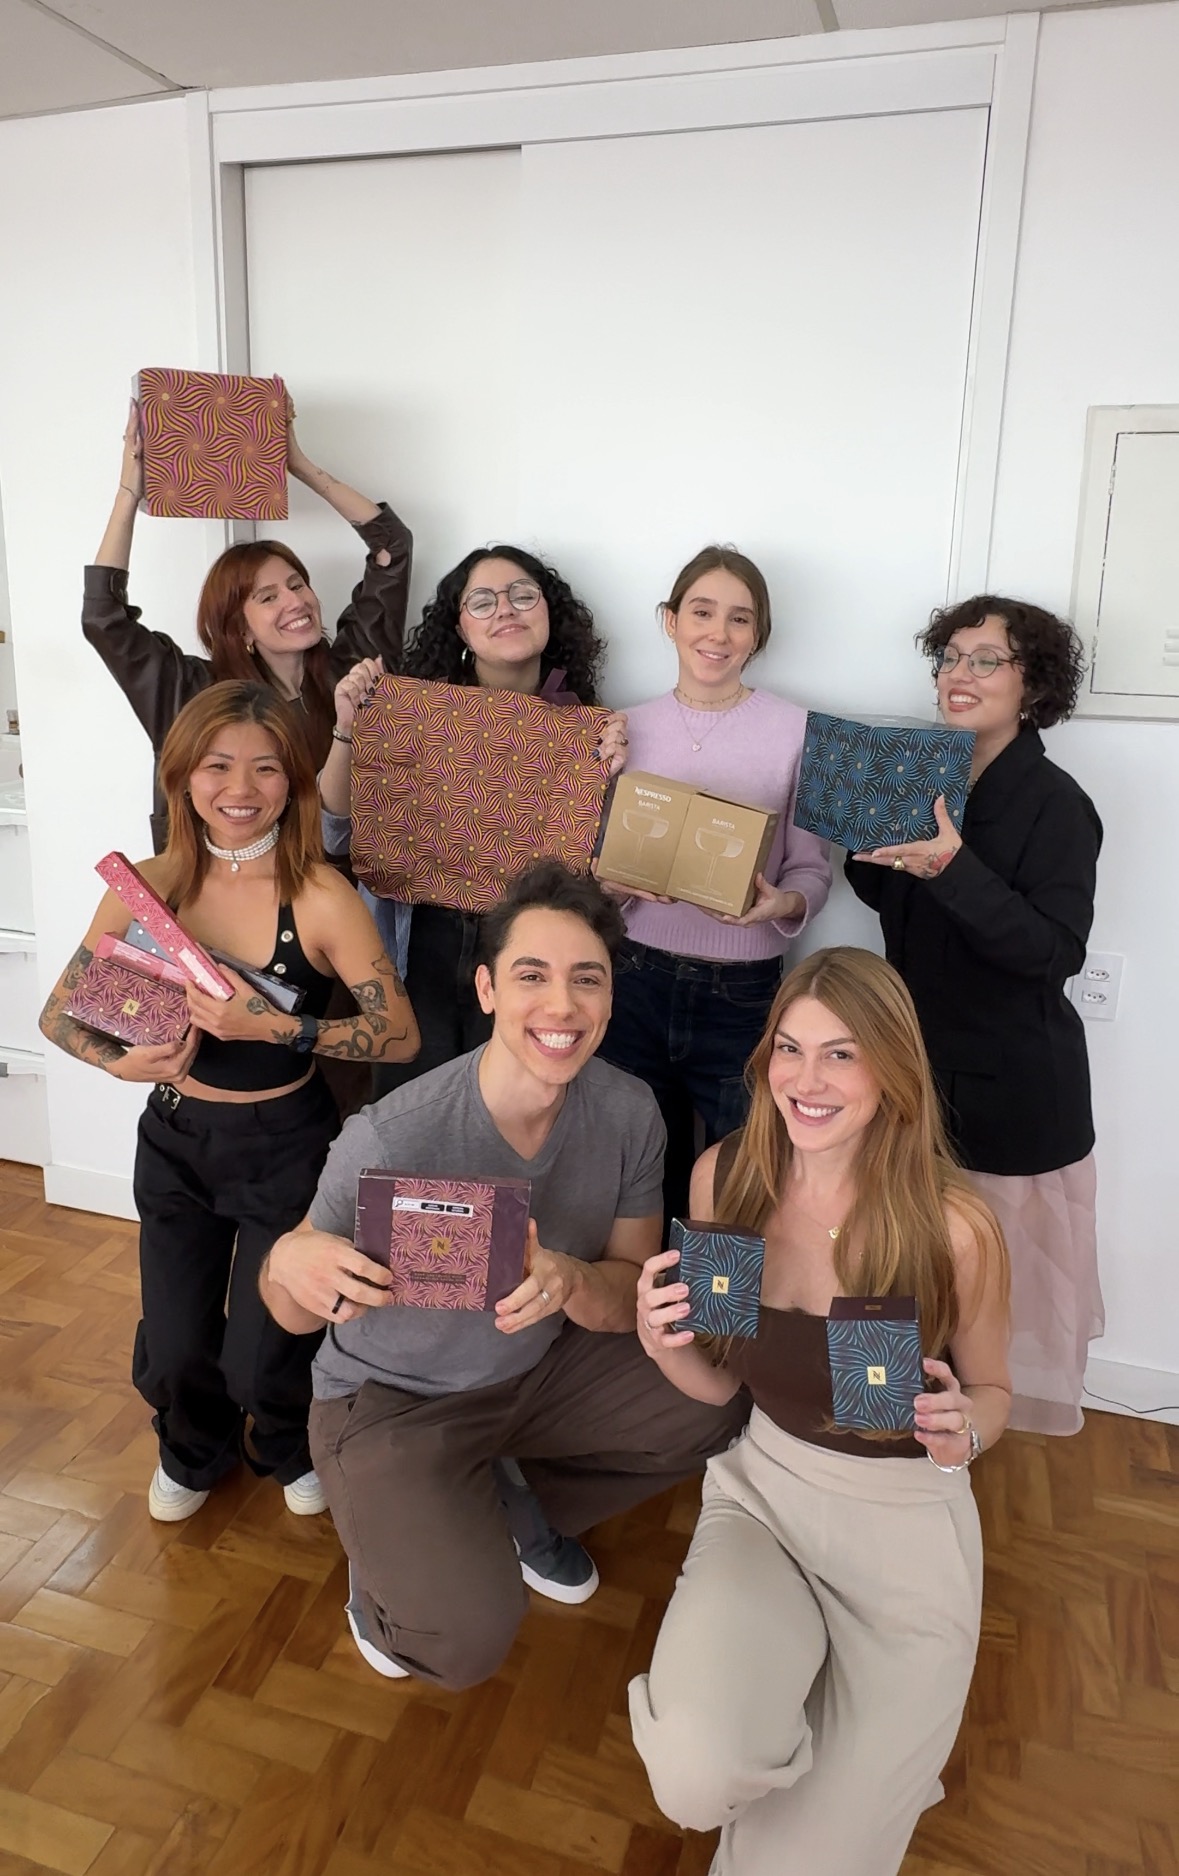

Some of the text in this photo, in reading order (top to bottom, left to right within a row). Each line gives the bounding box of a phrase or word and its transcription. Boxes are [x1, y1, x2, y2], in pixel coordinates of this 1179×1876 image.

[634, 786, 672, 803] NESPRESSO
[638, 800, 660, 811] BARISTA
[711, 818, 735, 830] BARISTA
